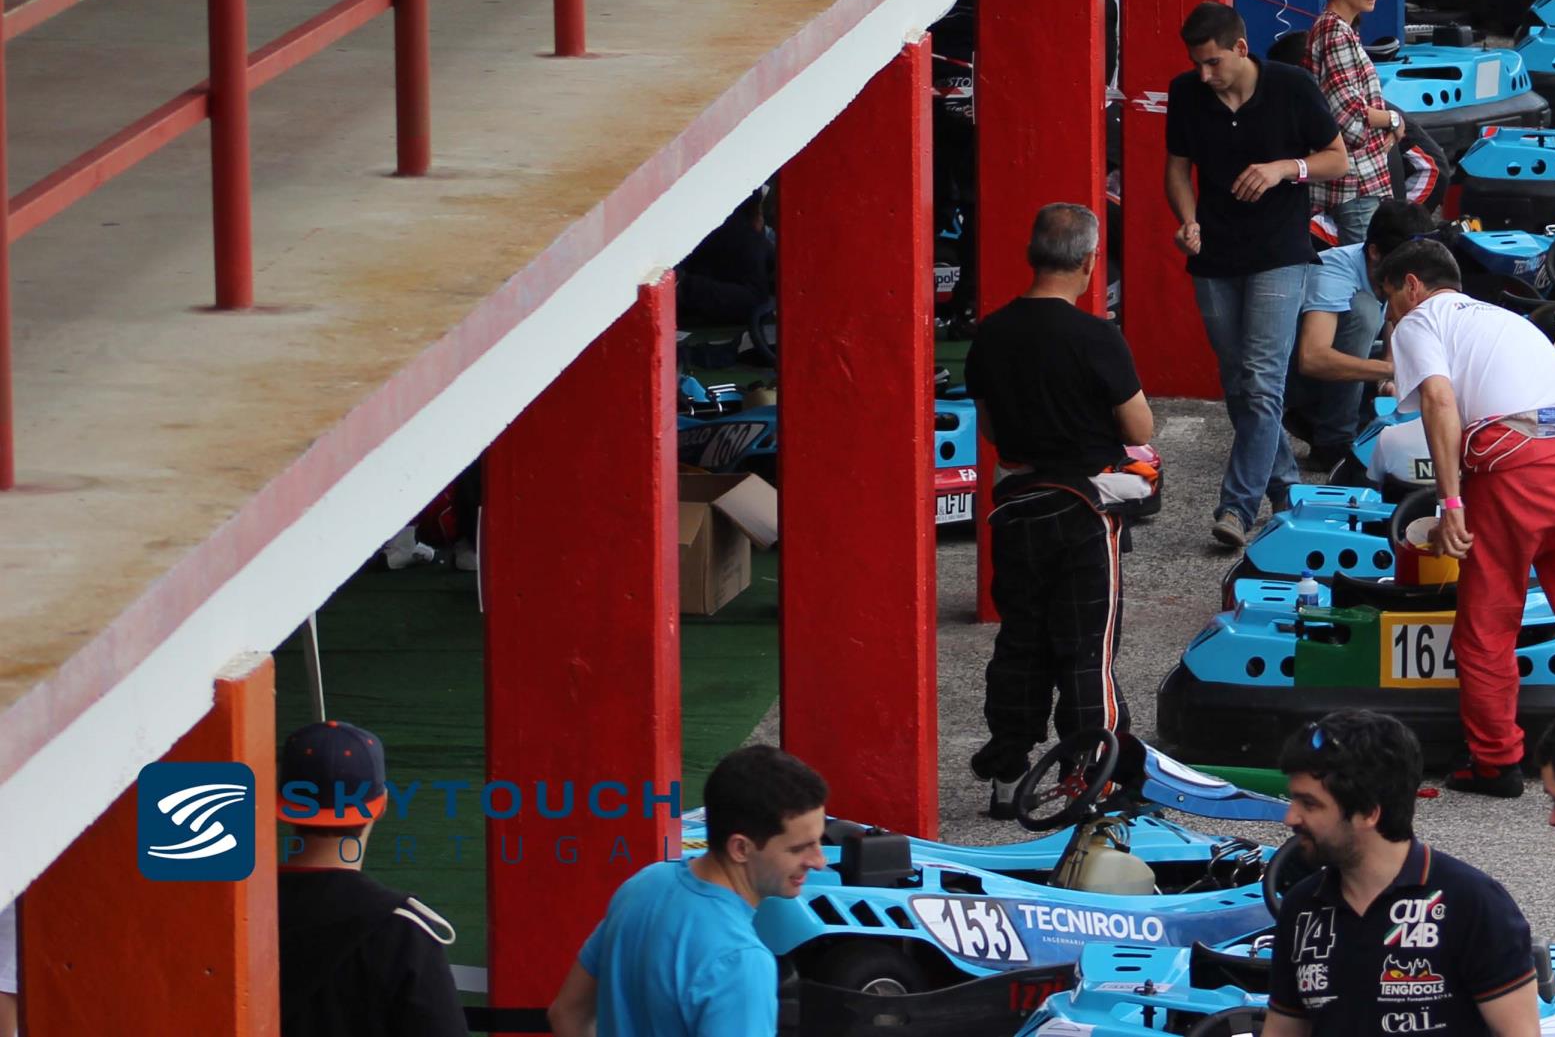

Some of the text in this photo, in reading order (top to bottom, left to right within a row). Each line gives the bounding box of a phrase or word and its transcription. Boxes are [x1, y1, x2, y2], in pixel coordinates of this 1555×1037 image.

[1018, 904, 1164, 942] TECNIROLO
[1389, 899, 1433, 924] CUT
[938, 898, 1012, 961] 153
[1401, 922, 1440, 948] LAB
